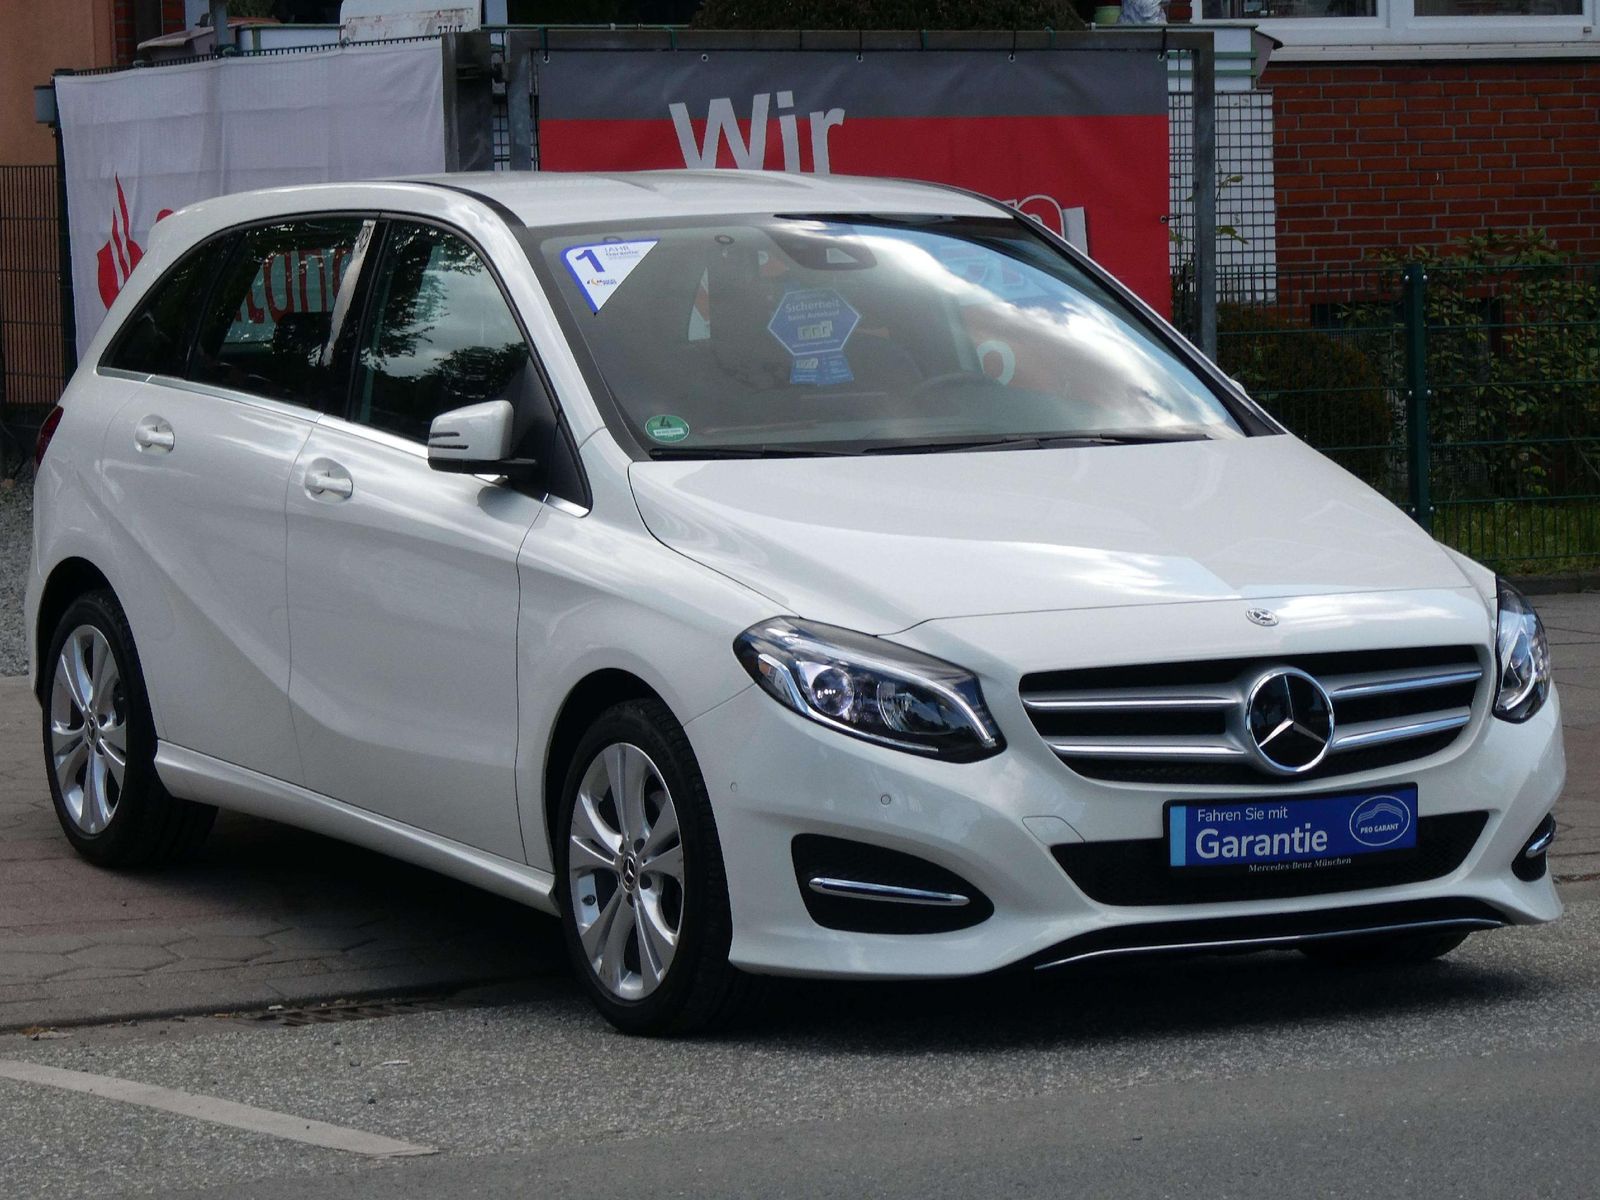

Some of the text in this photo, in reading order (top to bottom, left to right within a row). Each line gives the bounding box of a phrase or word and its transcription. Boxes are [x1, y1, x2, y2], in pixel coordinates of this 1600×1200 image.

[668, 90, 846, 174] Wir
[575, 249, 606, 273] 1
[660, 416, 672, 428] 4
[1197, 807, 1288, 822] Fahren Sie mit
[1360, 823, 1399, 834] PRO GARANT
[1195, 823, 1328, 859] Garantie
[1248, 857, 1352, 873] Mercedes-Benz München
